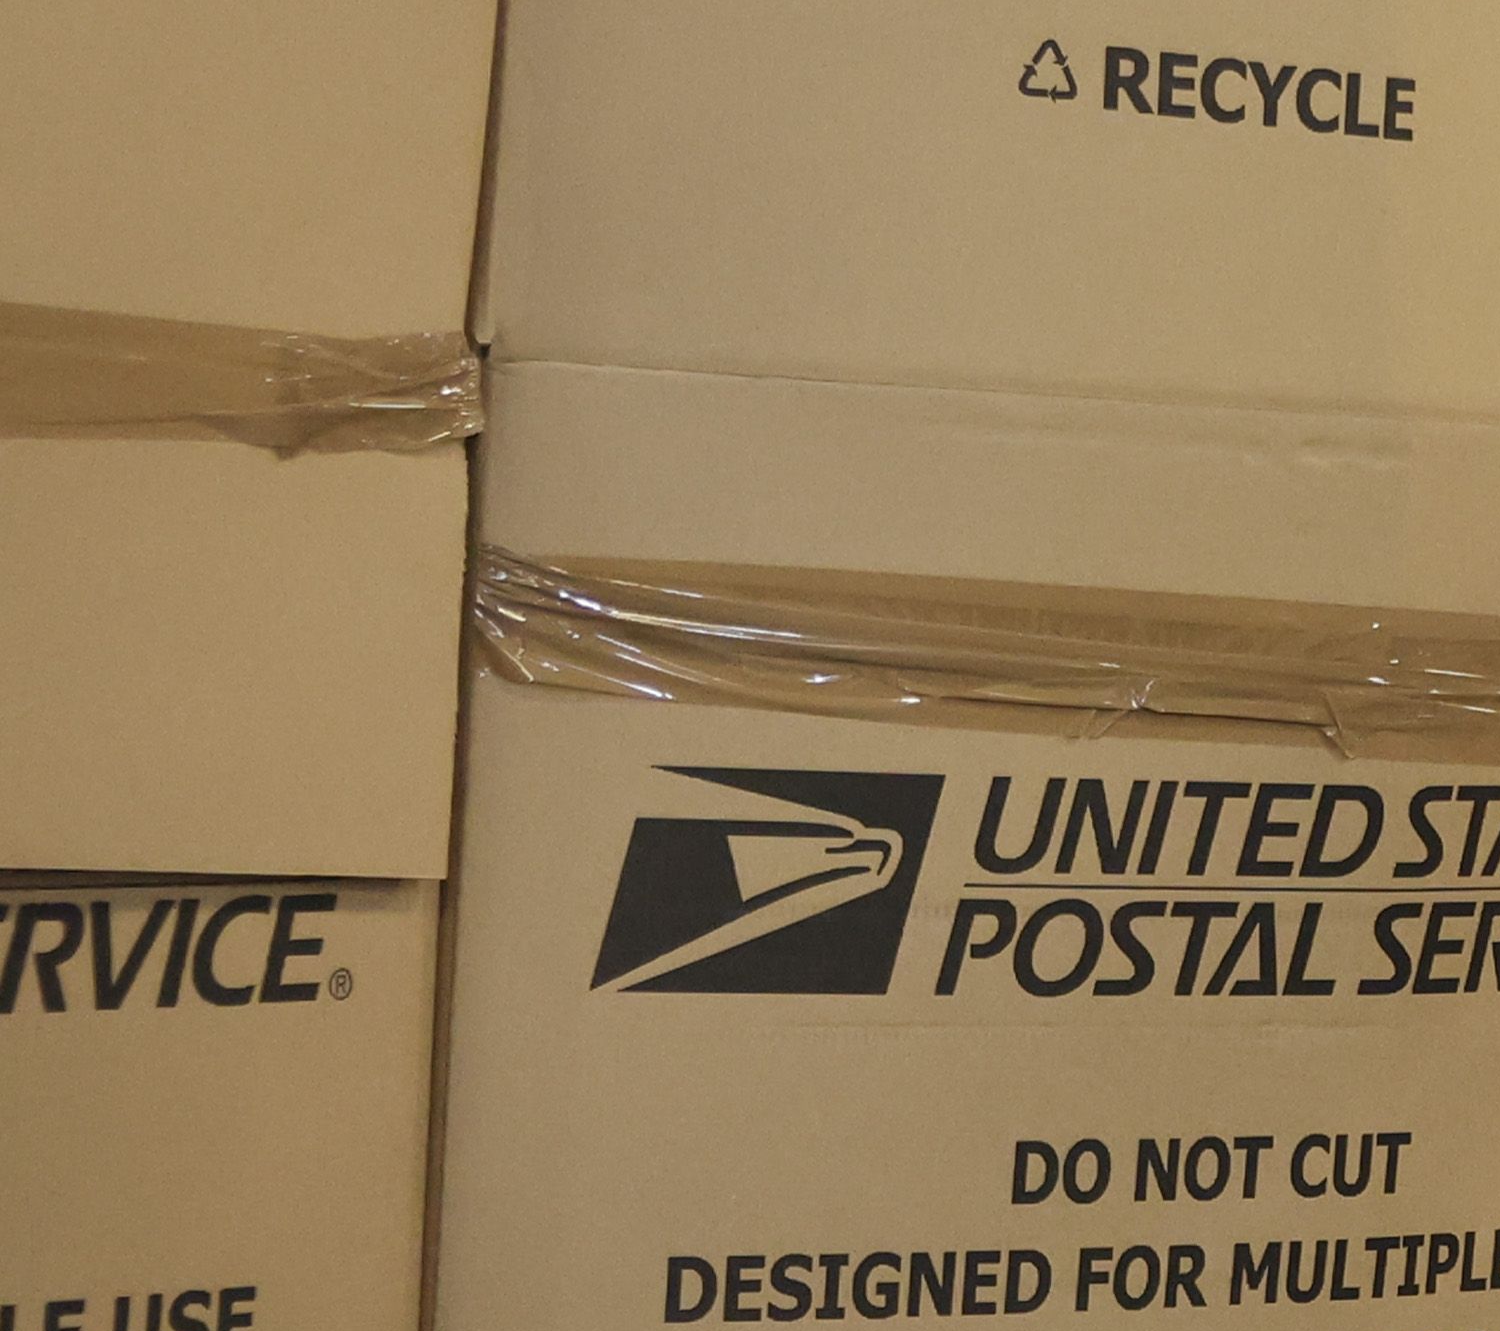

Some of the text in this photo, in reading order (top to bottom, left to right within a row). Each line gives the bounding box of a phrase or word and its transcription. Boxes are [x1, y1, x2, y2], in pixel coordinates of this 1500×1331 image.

[1102, 44, 1417, 144] RECYCLE
[970, 775, 1386, 878] UNITED
[933, 893, 1338, 998] POSTAL
[1011, 1131, 1412, 1206] DO NOT CUT
[663, 1249, 1053, 1324] DESIGNED
[1075, 1243, 1208, 1312] FOR
